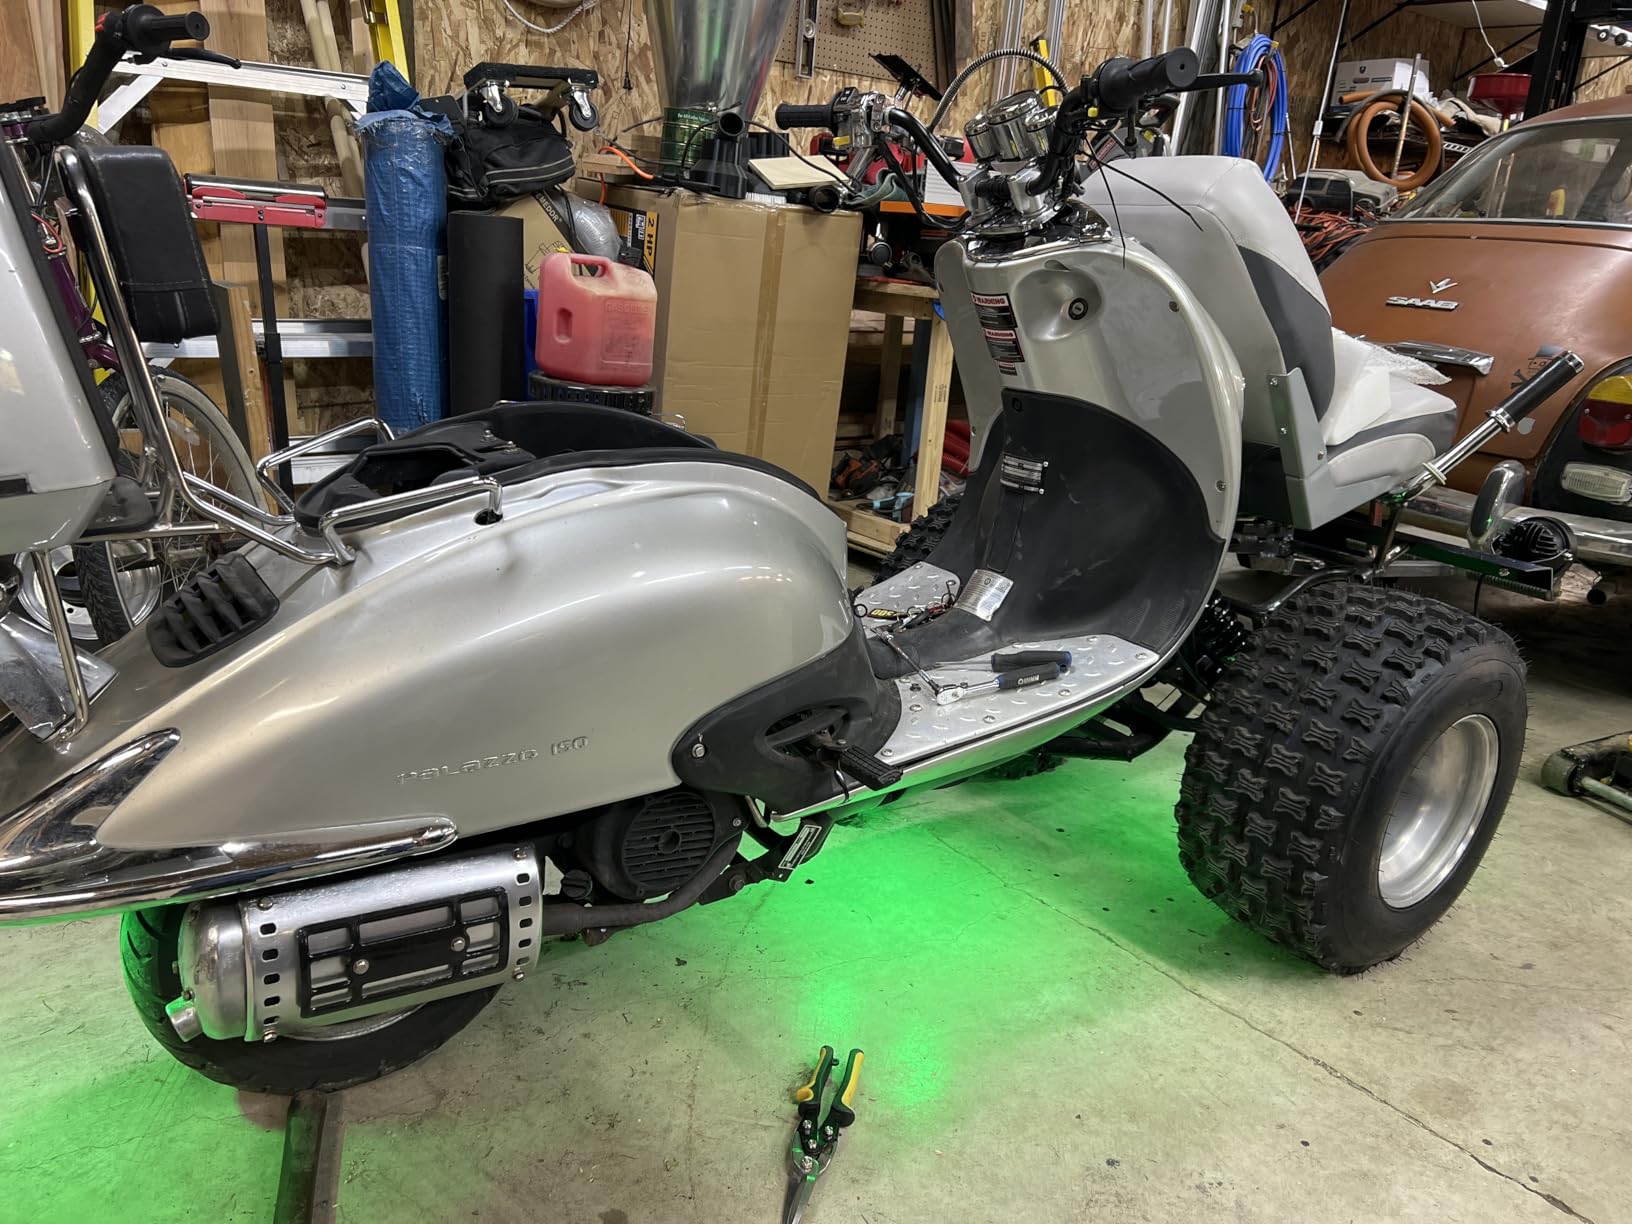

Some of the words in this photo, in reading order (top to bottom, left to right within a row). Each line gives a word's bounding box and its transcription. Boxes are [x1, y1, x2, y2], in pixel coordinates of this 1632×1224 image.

[648, 217, 655, 228] 2
[646, 233, 654, 257] HP
[977, 297, 1006, 305] WARNING
[1386, 296, 1459, 310] SAAB
[550, 735, 589, 757] 150
